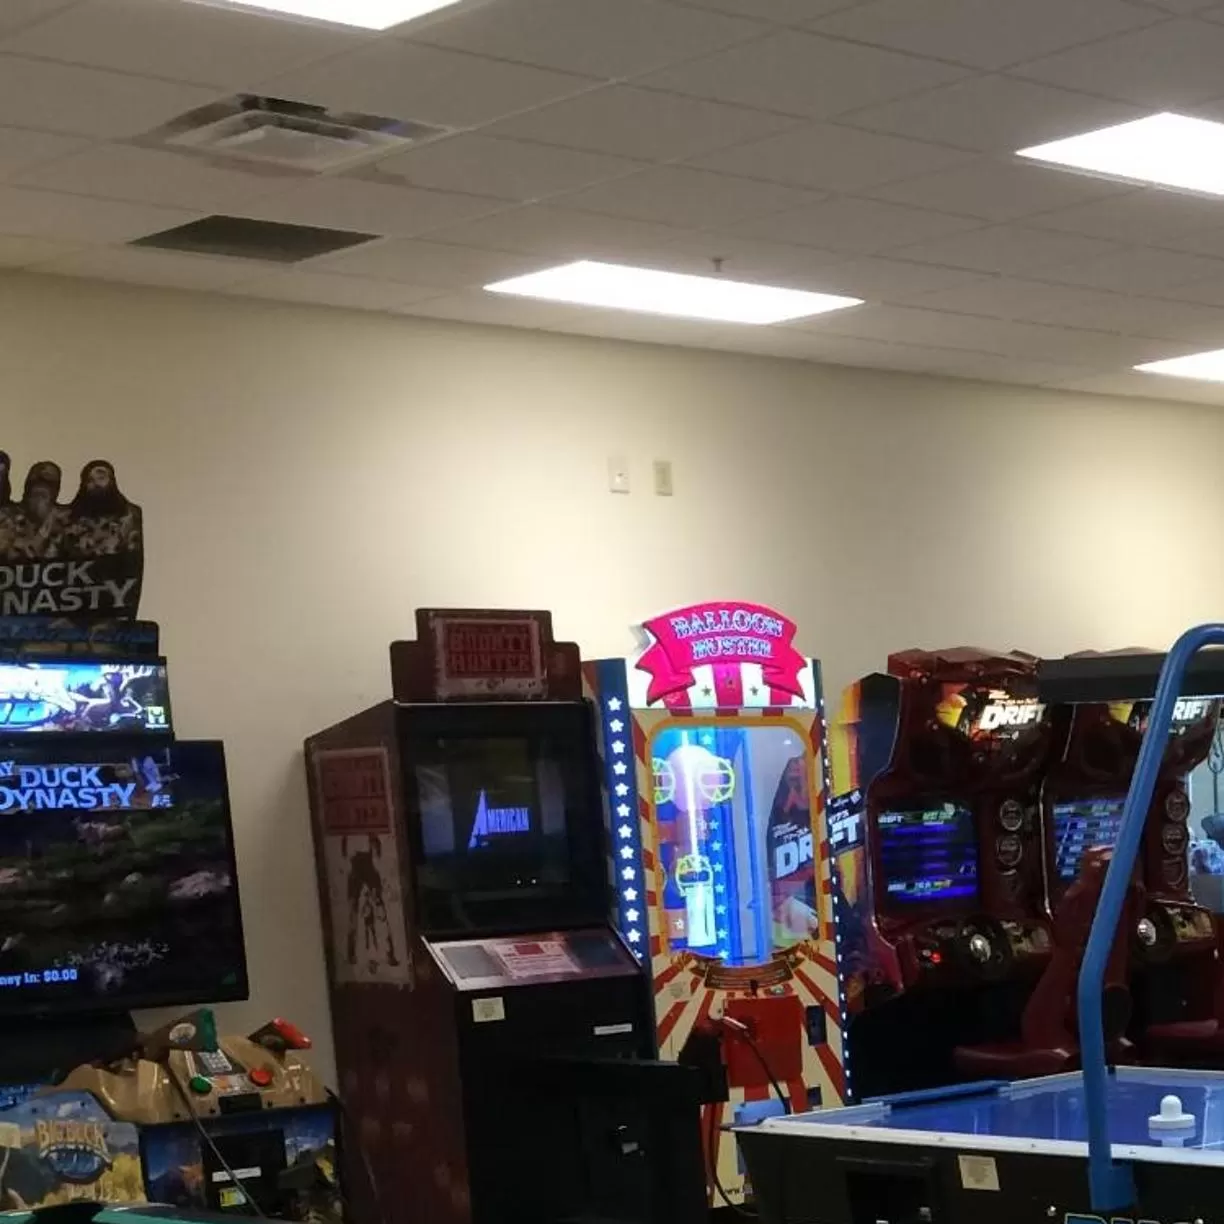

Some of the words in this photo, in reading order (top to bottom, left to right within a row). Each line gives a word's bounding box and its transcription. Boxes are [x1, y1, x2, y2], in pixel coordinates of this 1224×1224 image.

[0, 560, 95, 590] DUCK
[979, 703, 1047, 731] DRIFT
[1171, 700, 1212, 721] RIFT
[20, 766, 103, 788] DUCK
[0, 783, 136, 810] DYNASTY
